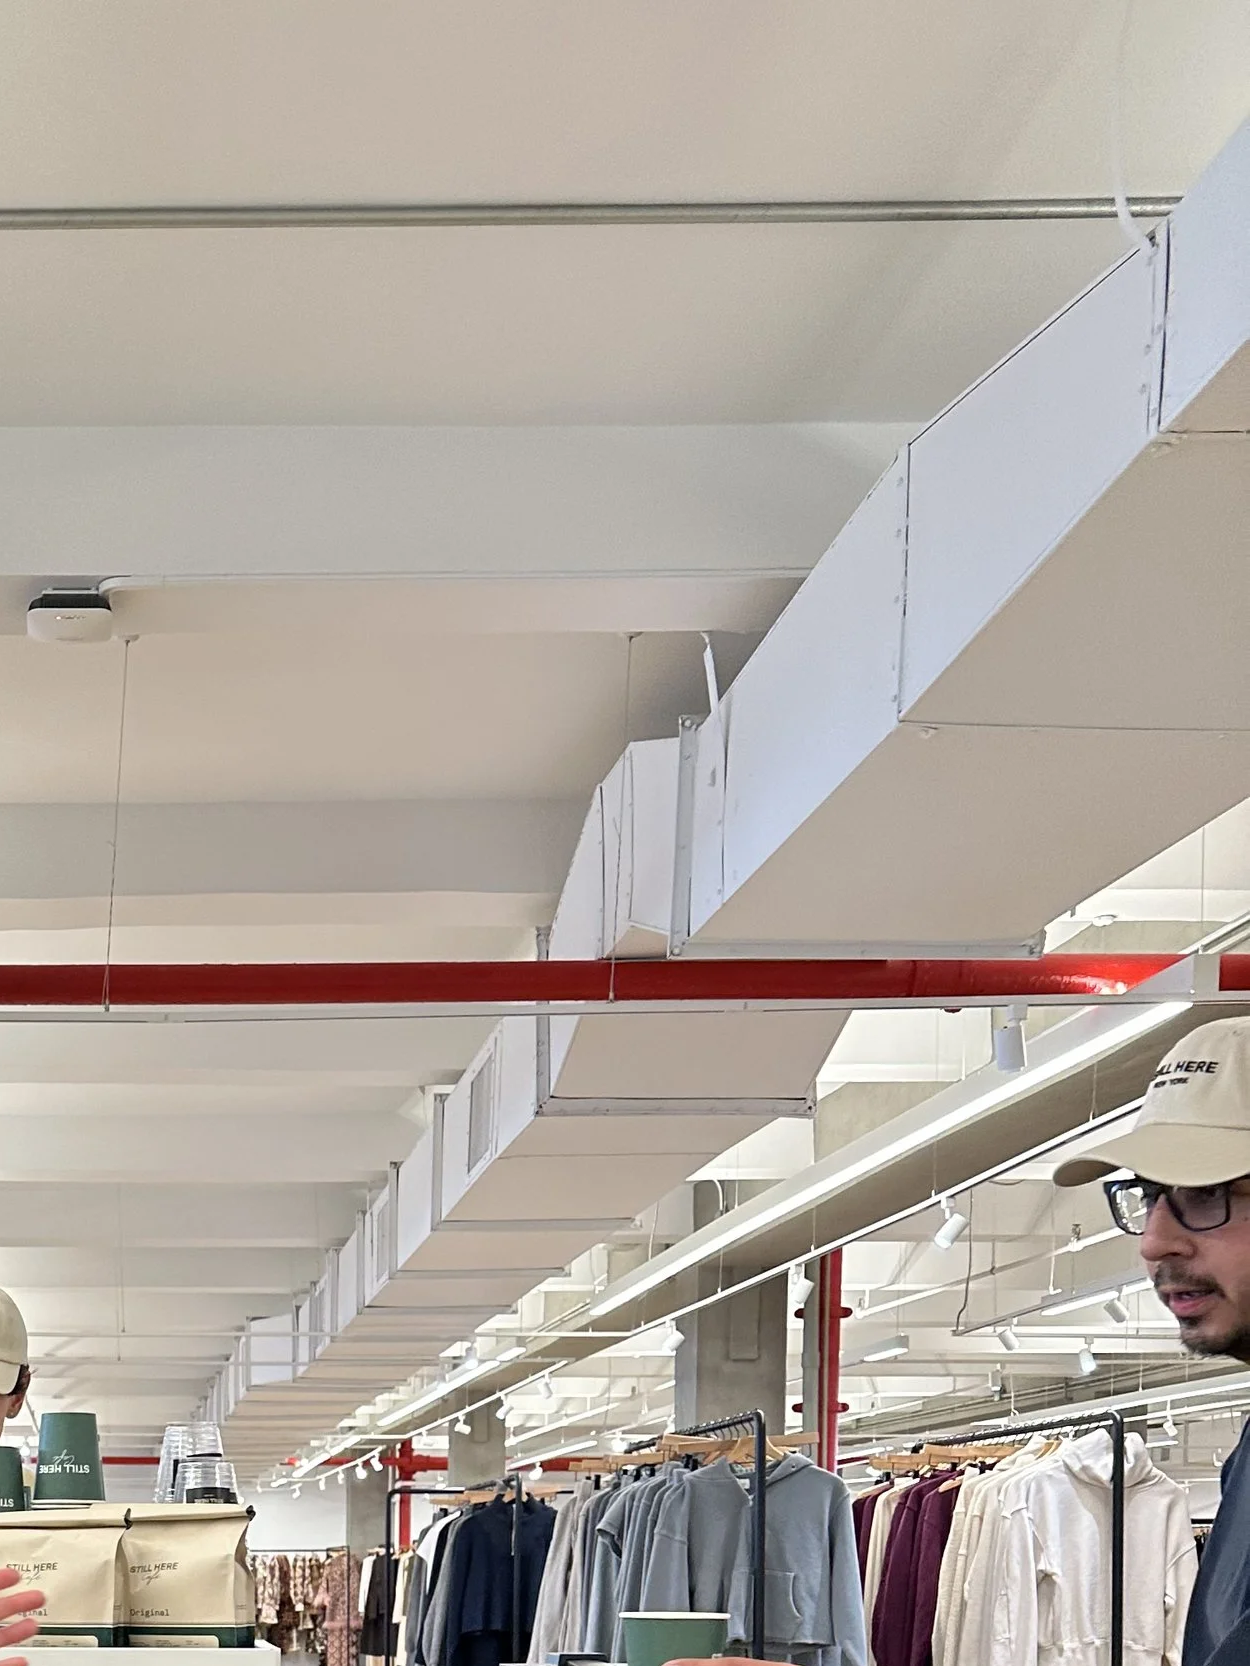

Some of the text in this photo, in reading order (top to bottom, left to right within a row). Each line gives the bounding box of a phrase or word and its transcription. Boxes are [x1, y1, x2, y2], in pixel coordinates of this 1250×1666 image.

[1174, 1061, 1219, 1073] HERE
[38, 1464, 90, 1474] STILL HERE
[33, 1562, 58, 1571] HERE
[129, 1561, 179, 1573] STILL HERE
[129, 1608, 170, 1618] Original
